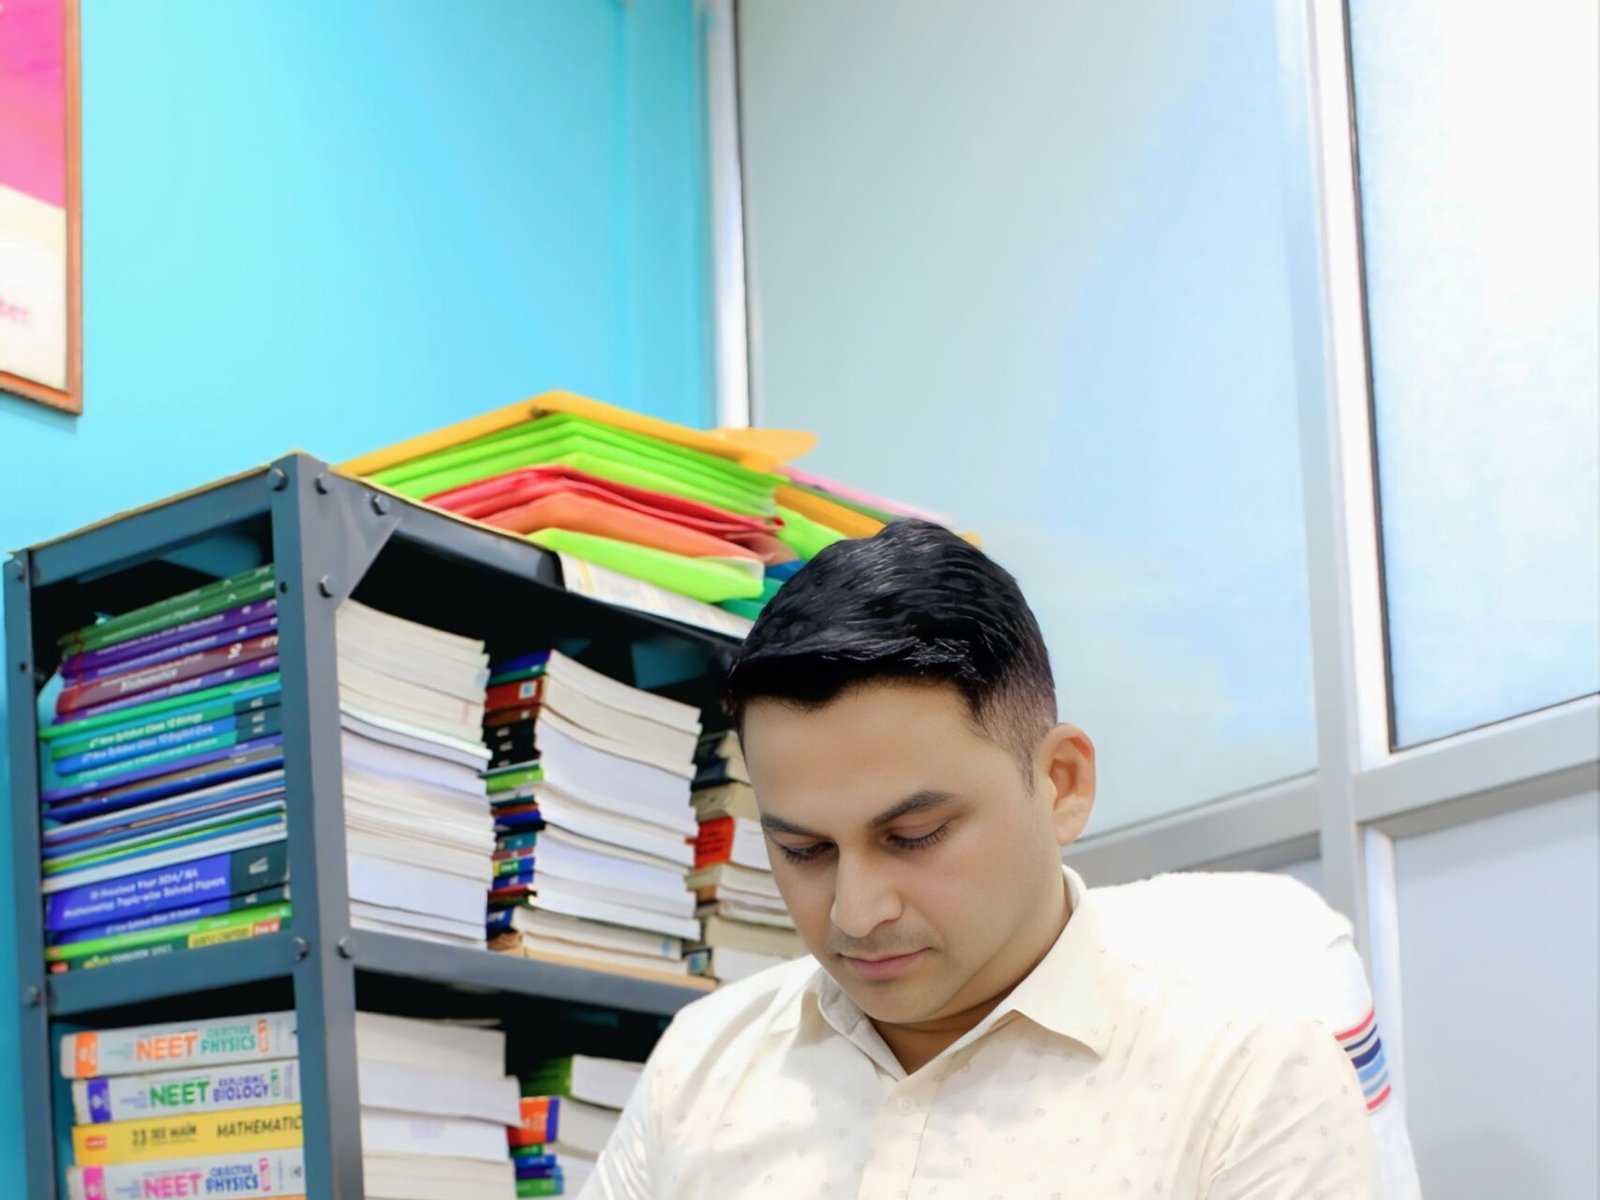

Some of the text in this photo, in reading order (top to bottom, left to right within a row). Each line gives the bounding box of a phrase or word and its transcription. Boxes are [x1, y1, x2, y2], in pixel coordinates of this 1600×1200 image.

[162, 882, 194, 899] Solved
[195, 876, 226, 892] Papers
[136, 1033, 198, 1062] NEET
[201, 1035, 257, 1054] PHYSICS
[151, 1080, 210, 1107] NEET
[213, 1083, 269, 1103] BIOLOGY
[216, 1116, 303, 1139] MATHEMATIC
[144, 1173, 203, 1199] NEET
[205, 1174, 260, 1194] PHYSICS
